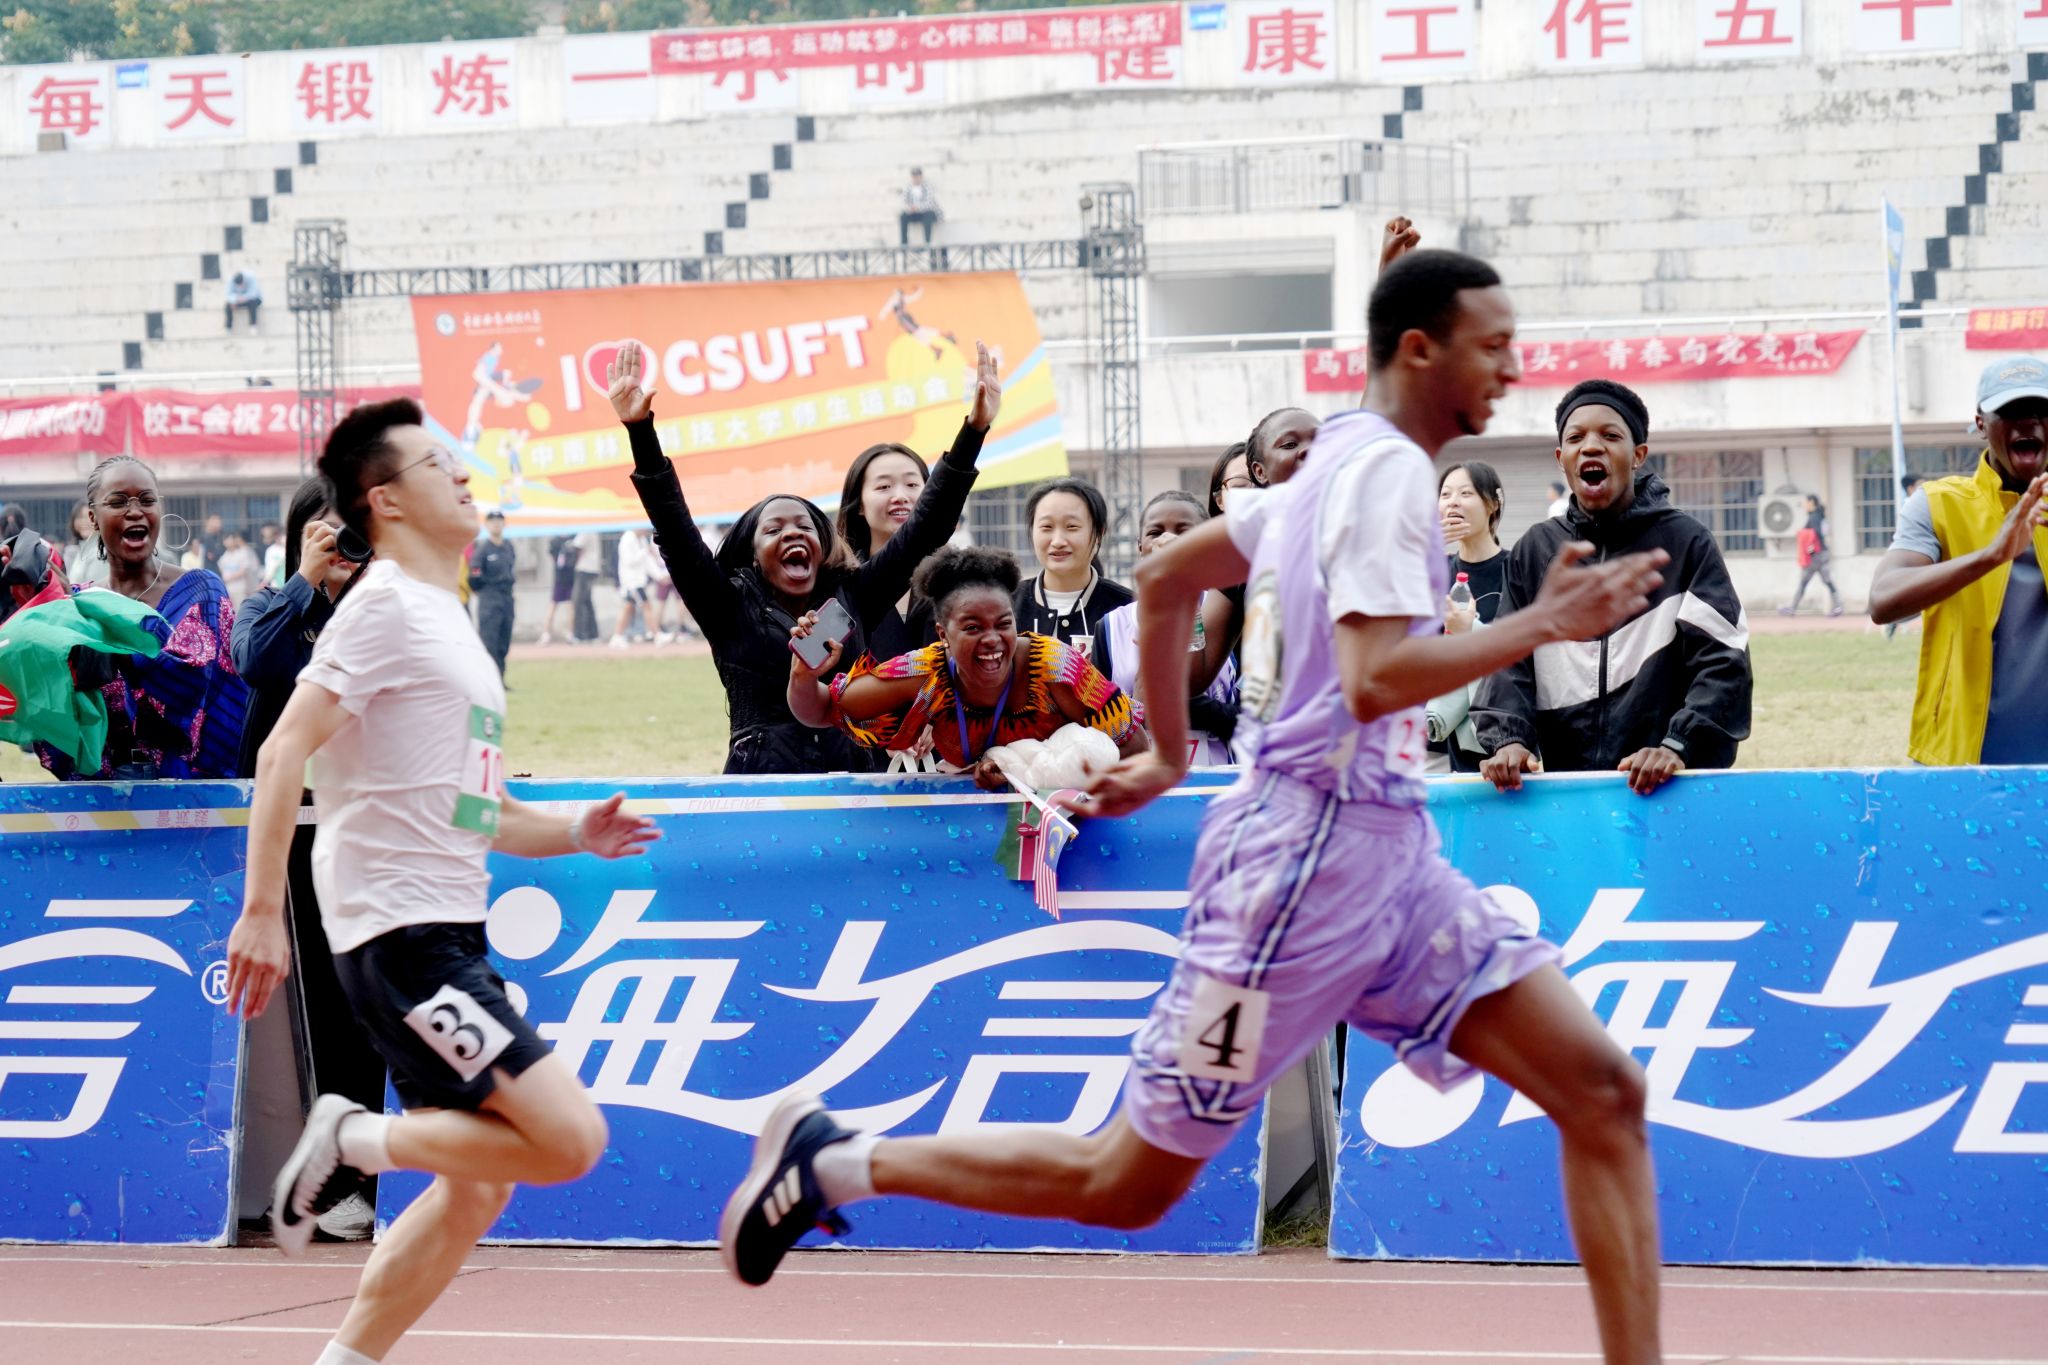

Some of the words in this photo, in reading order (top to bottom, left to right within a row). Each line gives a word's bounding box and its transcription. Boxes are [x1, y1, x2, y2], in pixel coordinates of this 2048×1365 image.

[1094, 0, 2048, 83] 健康工作五十
[560, 354, 583, 412] I
[663, 314, 869, 396] CSUFT
[530, 375, 949, 469] 中南林科技大学师生运动会
[429, 1002, 486, 1061] 3
[1199, 1001, 1245, 1069] 4
